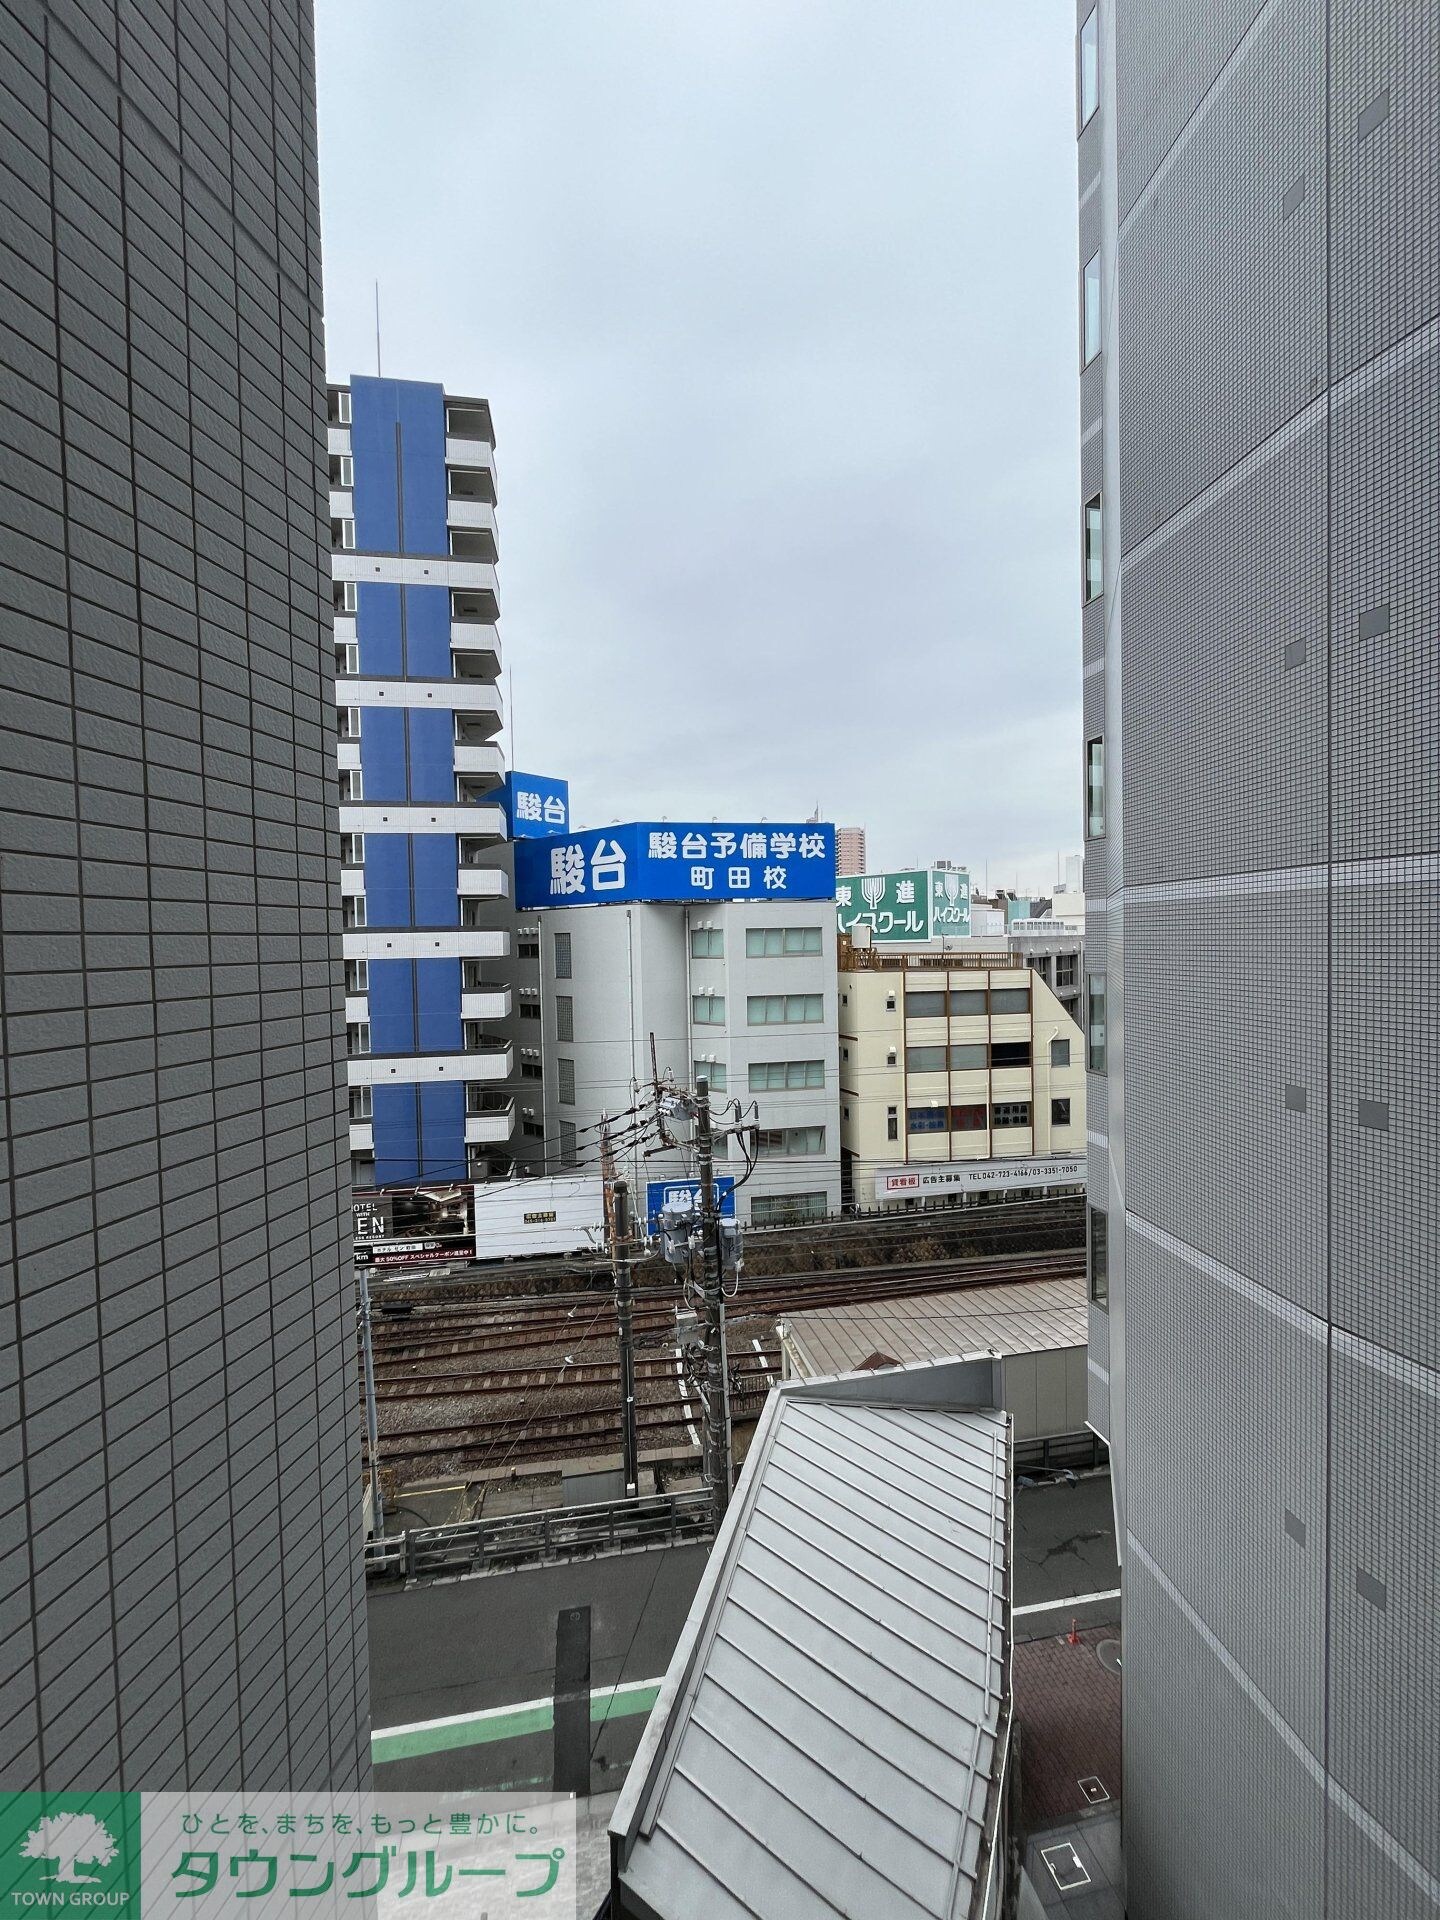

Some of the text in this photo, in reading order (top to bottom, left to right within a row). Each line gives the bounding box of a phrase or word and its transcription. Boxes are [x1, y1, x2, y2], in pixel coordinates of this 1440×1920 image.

[516, 791, 566, 825] 駿台
[647, 832, 826, 860] 駿台予備学校
[549, 838, 628, 896] 駿台
[933, 906, 971, 923] ハイスクール
[351, 1203, 378, 1212] OTEL
